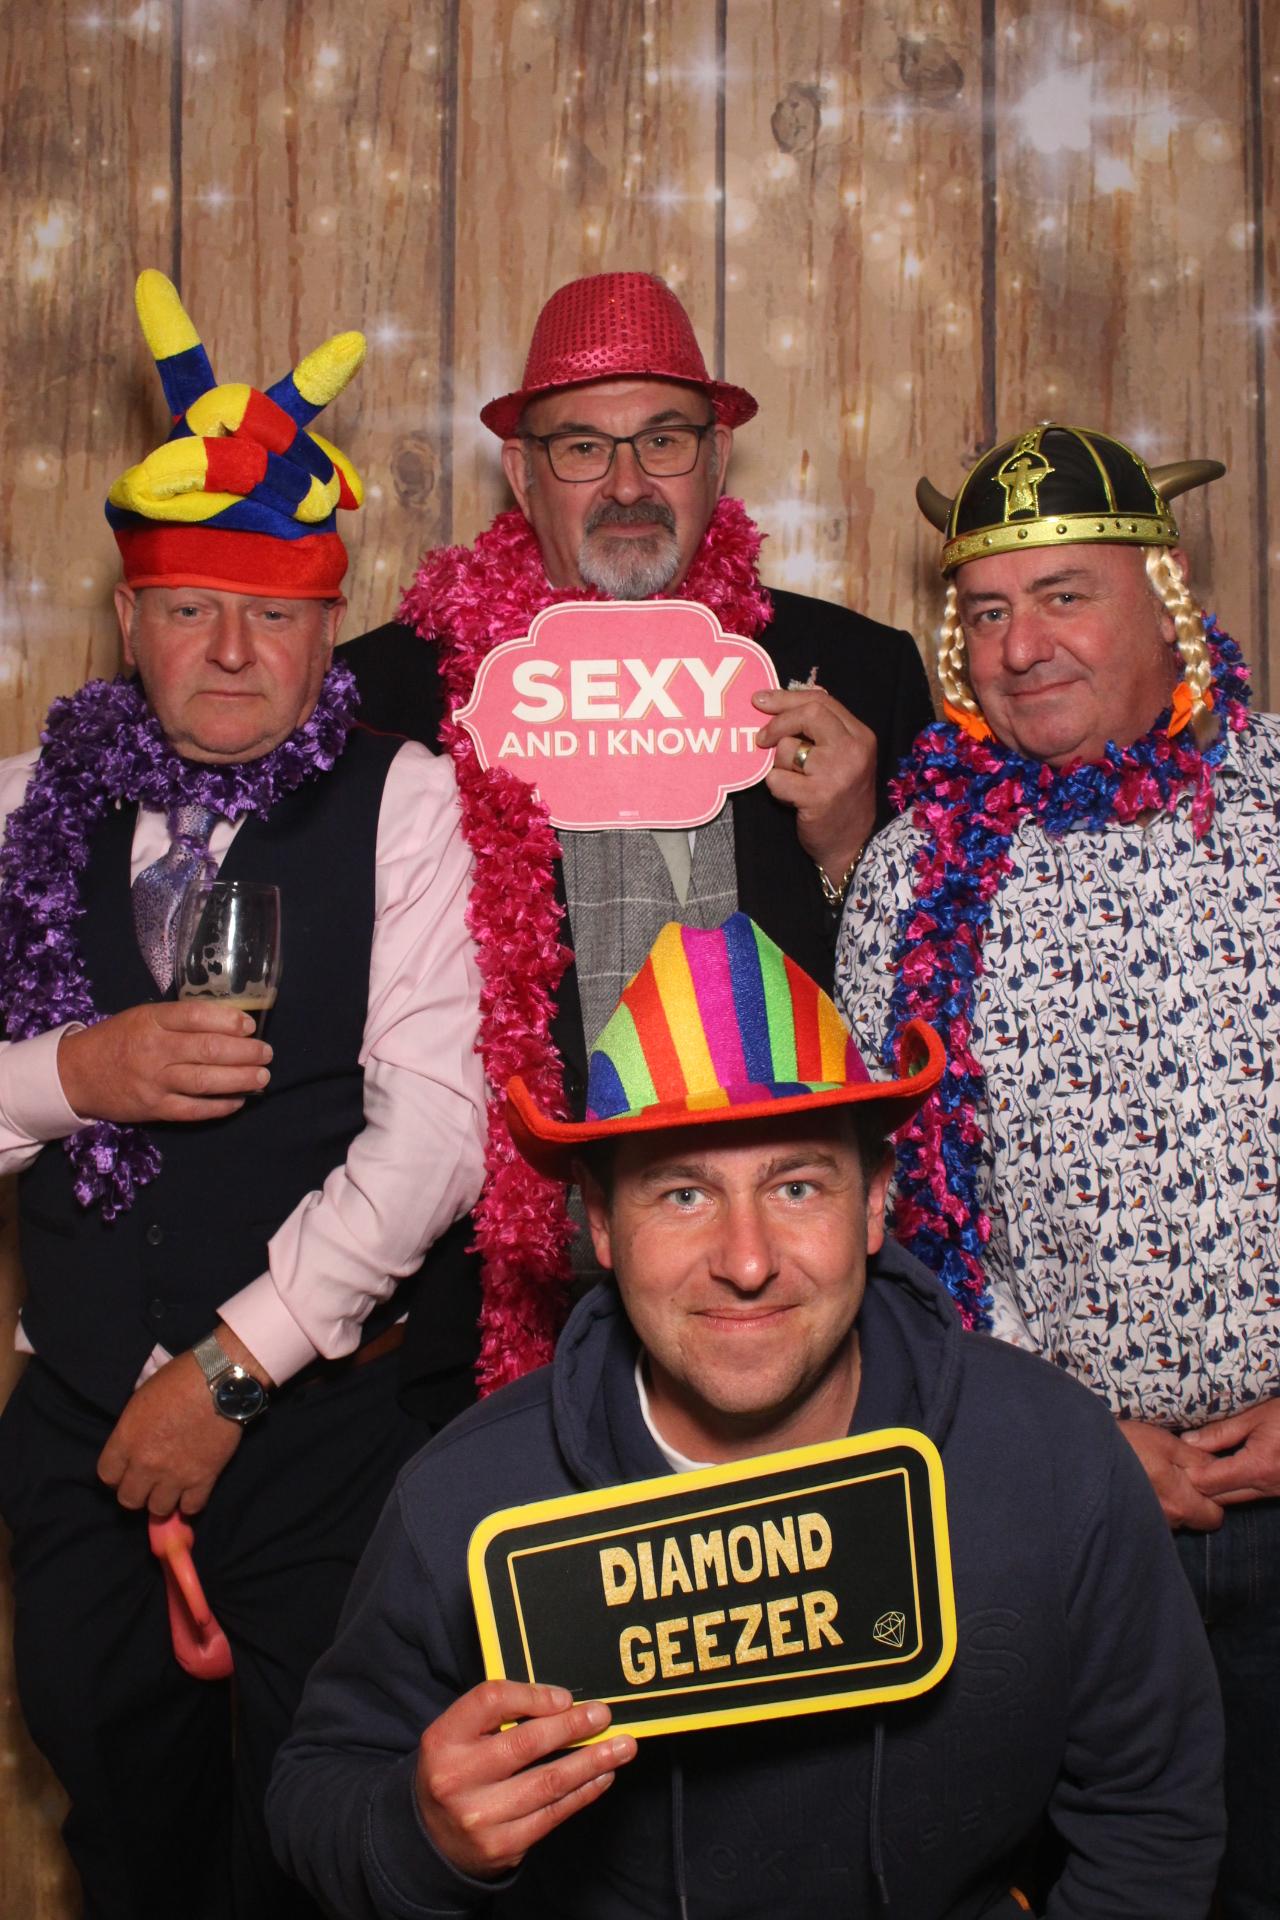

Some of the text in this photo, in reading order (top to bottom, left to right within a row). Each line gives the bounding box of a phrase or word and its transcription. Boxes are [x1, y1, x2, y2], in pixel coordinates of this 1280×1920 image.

[511, 656, 745, 723] SEXY
[498, 726, 761, 758] AND I KNOW IT
[599, 1512, 833, 1607] DIAMOND
[619, 1589, 844, 1686] GEEZER
